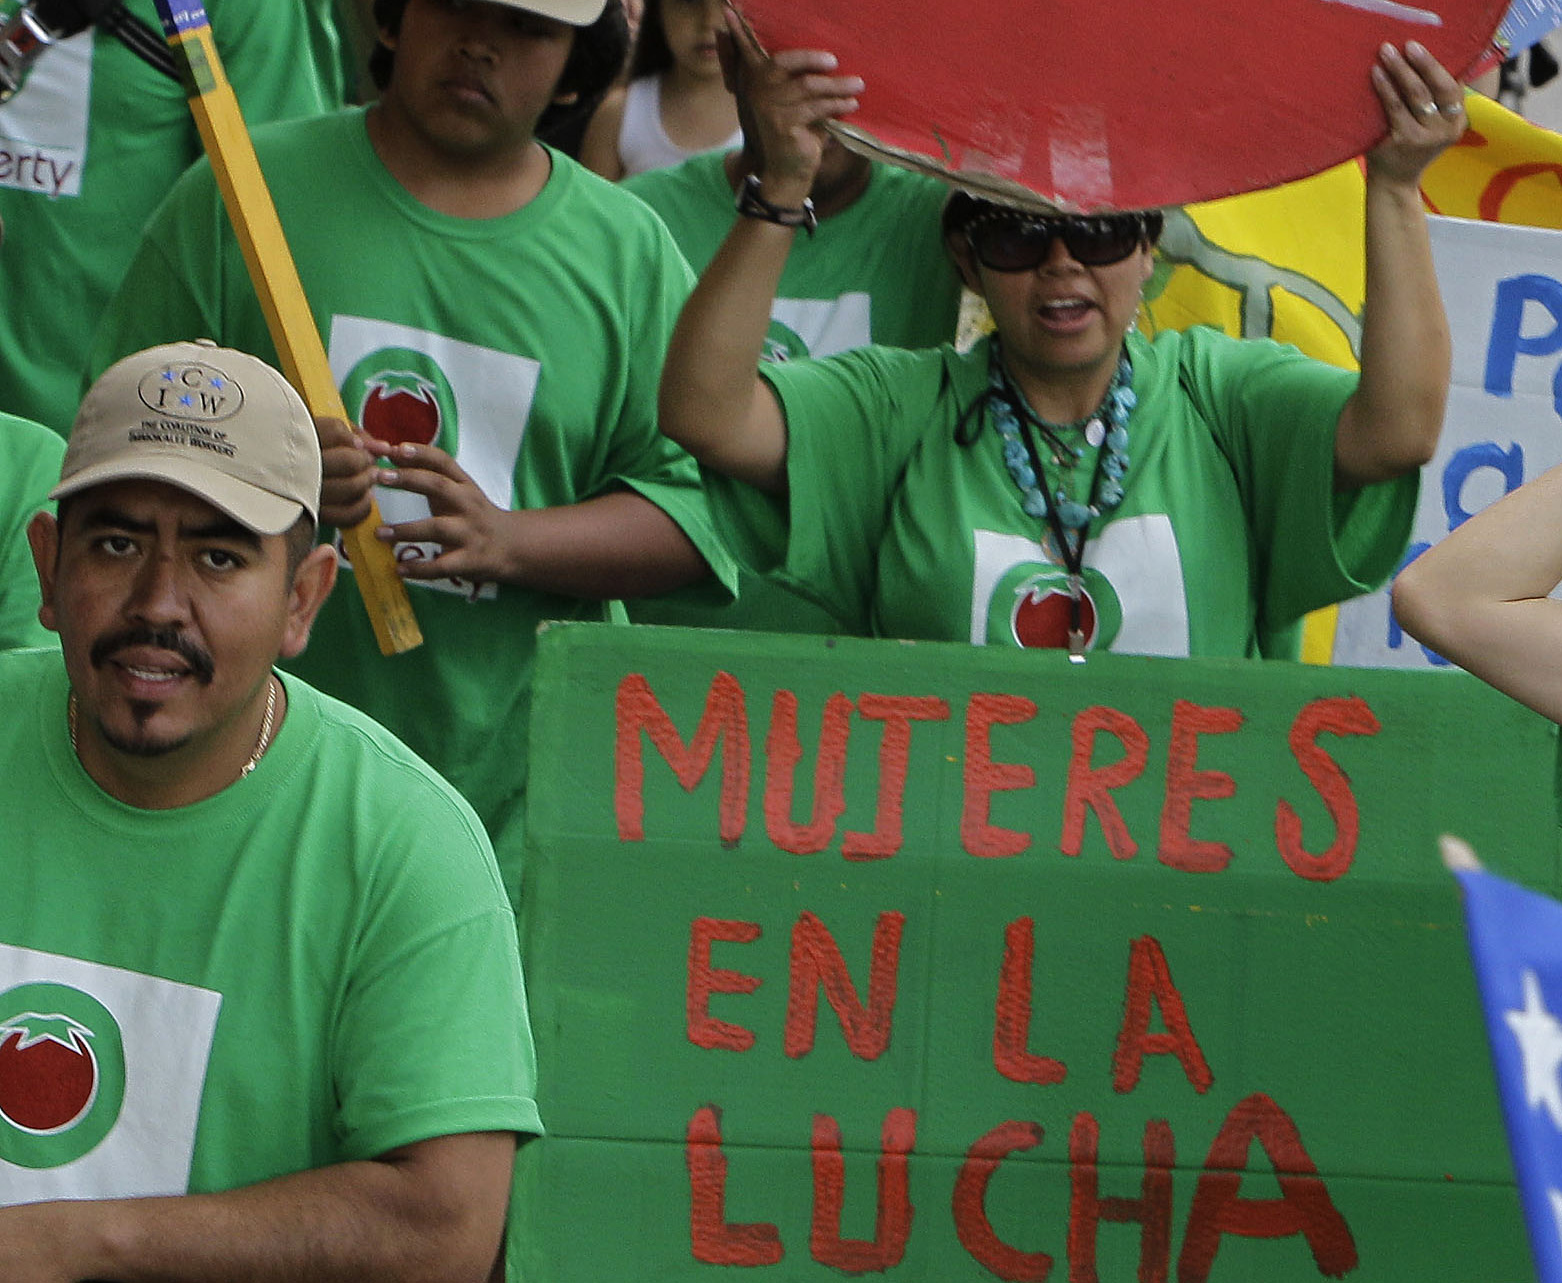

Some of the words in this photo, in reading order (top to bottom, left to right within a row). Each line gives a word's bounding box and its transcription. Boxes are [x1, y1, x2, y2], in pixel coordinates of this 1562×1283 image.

[181, 366, 203, 388] C
[615, 670, 1382, 882] MUJERES
[687, 910, 906, 1061] EN
[992, 916, 1214, 1094] LA
[686, 1092, 1359, 1283] LUCHA
